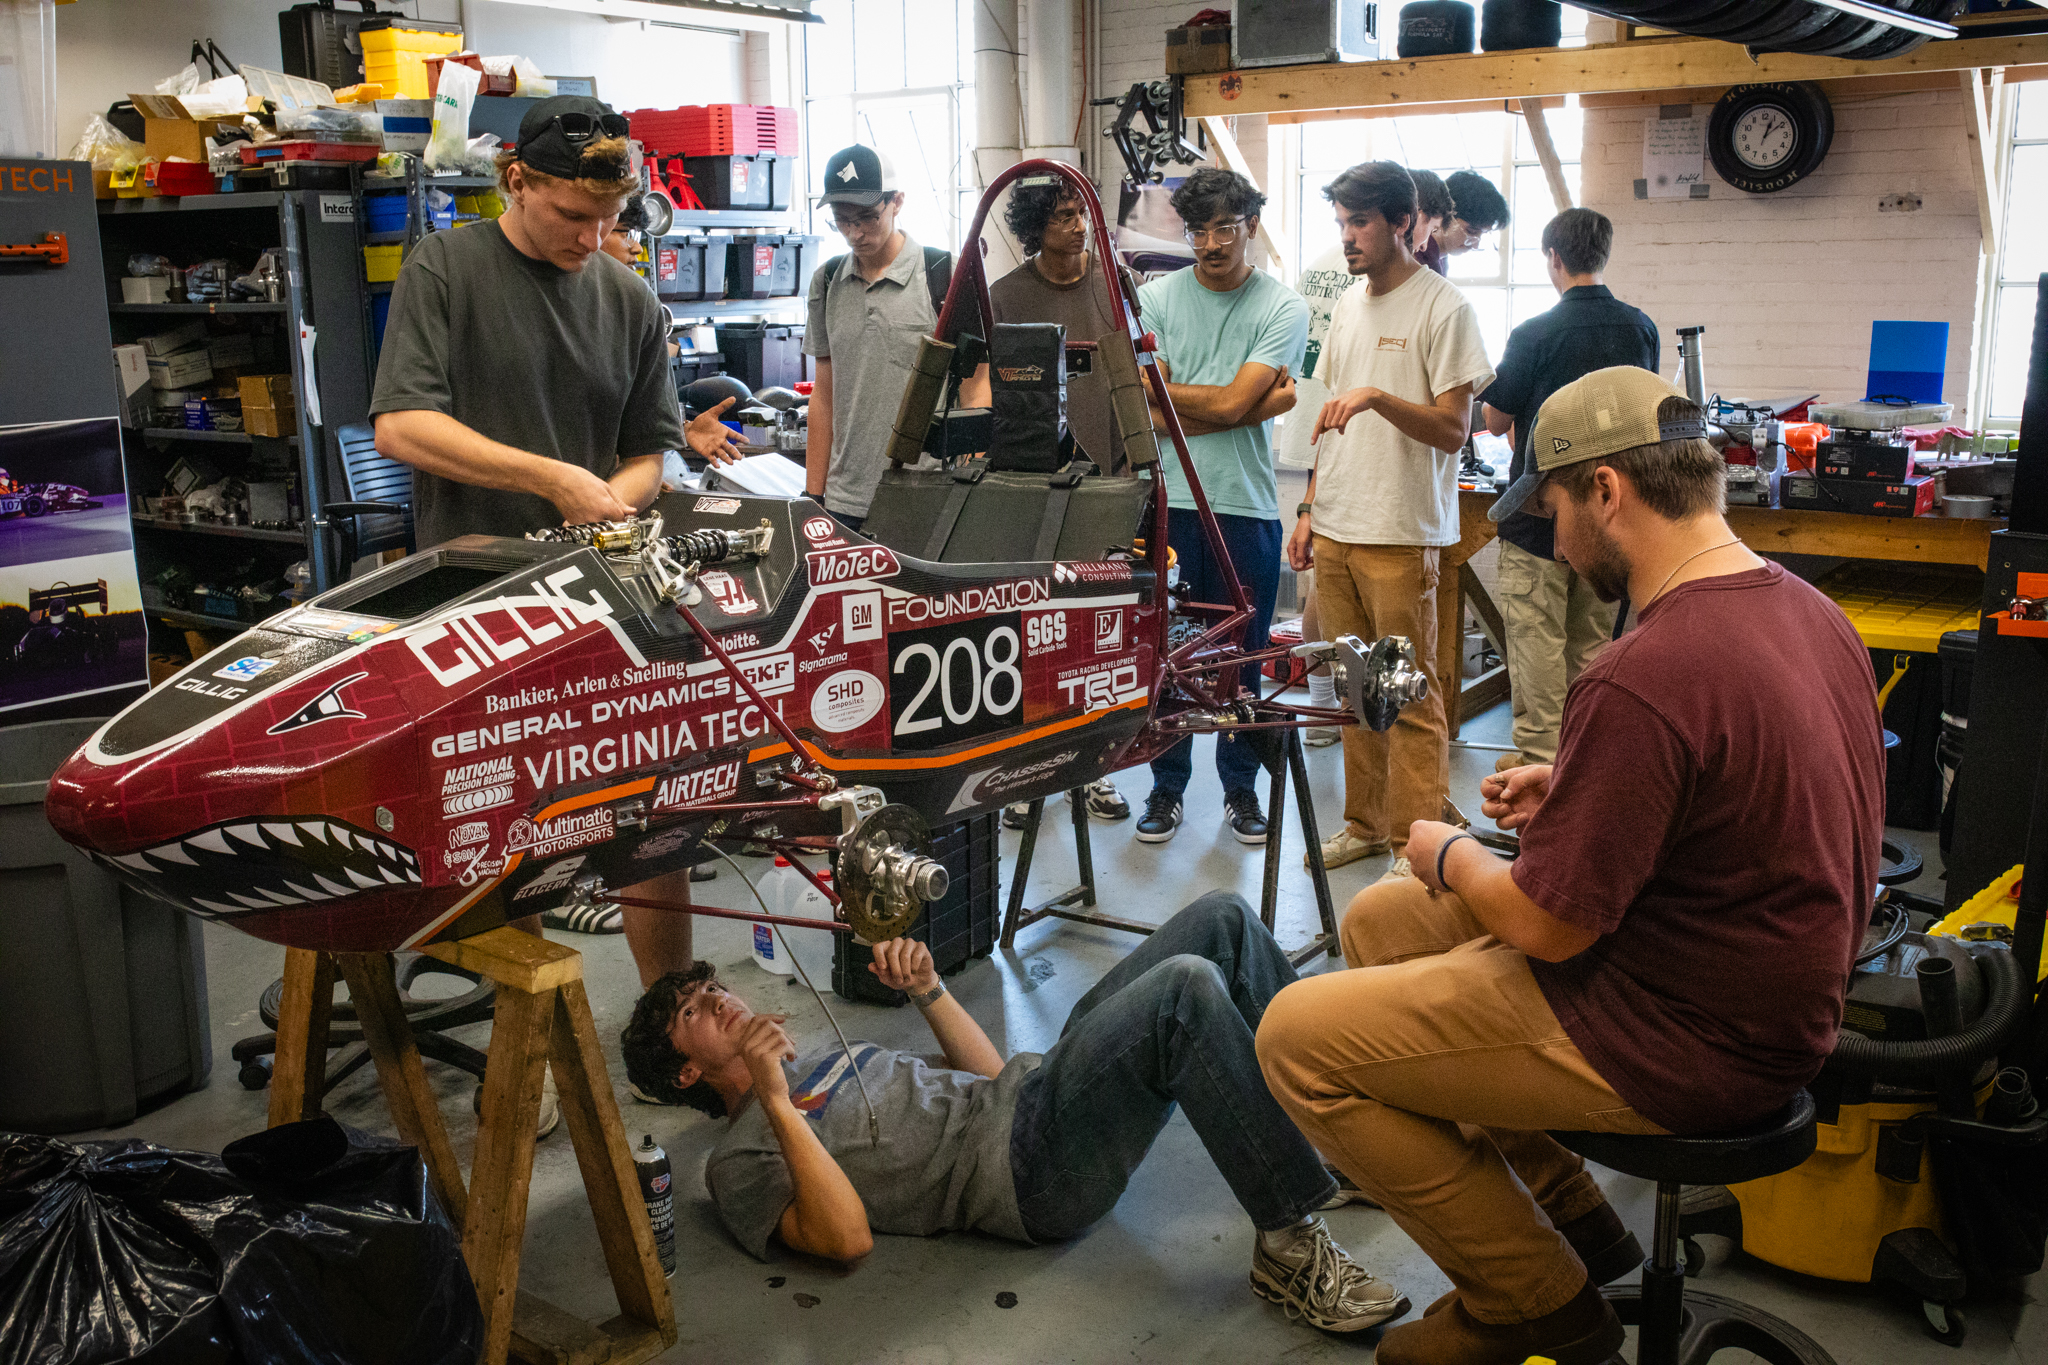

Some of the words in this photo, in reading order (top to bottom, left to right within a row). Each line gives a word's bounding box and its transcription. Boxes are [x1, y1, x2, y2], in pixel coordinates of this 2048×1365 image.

[1744, 124, 1752, 132] 10
[1752, 116, 1757, 124] 11
[1761, 113, 1770, 121] 12
[1779, 121, 1786, 129] 2
[1782, 131, 1789, 139] 3
[1761, 152, 1768, 160] 6
[1772, 149, 1778, 157] 5
[808, 520, 830, 538] IR
[815, 549, 889, 583] MoTeC
[1072, 562, 1131, 573] HILLMANN
[1082, 572, 1132, 582] CONSULTING
[888, 577, 1050, 625] FOUNDATION
[405, 565, 614, 687] GILLIG
[851, 604, 872, 625] GM
[1026, 611, 1067, 648] SGS
[1028, 647, 1039, 657] Solid
[1039, 644, 1056, 655] Carbide
[1056, 642, 1067, 650] Tools
[227, 657, 273, 675] SAE
[743, 660, 789, 686] SKF
[799, 652, 848, 673] Signarama
[1058, 669, 1078, 680] TOYOTA
[1079, 664, 1099, 675] RACING
[1100, 655, 1137, 670] DEVELOPMENT
[175, 677, 249, 700] GILLIG
[485, 687, 559, 715] Bankier,
[561, 677, 608, 700] Arlen
[610, 674, 622, 689] &
[623, 660, 687, 687] Snelling
[827, 679, 864, 703] SHD
[892, 626, 1023, 736] 208
[1057, 664, 1138, 711] TRD
[828, 697, 865, 711] composites
[431, 710, 582, 758] GENERAL
[591, 676, 731, 724] DYNAMICS
[524, 719, 698, 790] VIRGINIA
[700, 698, 783, 746] TECH
[444, 755, 514, 785] NATIONAL
[441, 777, 482, 796] PRECISION
[483, 769, 516, 786] BEARING
[652, 760, 741, 809] AIRTECH
[716, 788, 737, 799] GROUP
[533, 807, 614, 842] Multimatic
[534, 826, 614, 857] MOTORSPORTS
[476, 859, 503, 870] PRECISION
[513, 877, 571, 901] GLACERN
